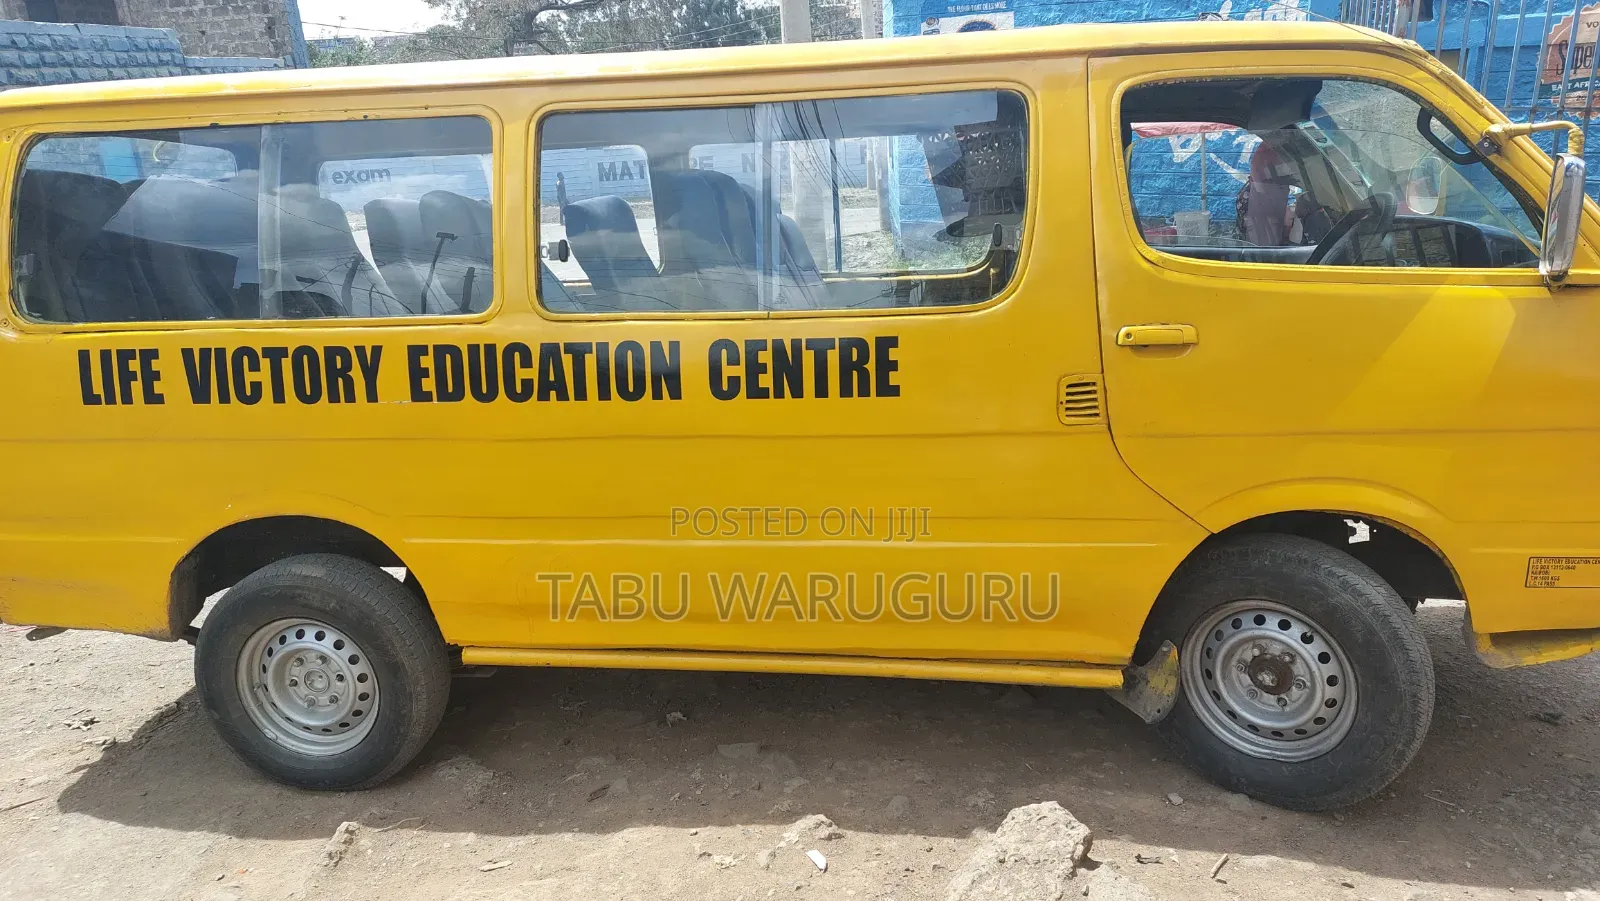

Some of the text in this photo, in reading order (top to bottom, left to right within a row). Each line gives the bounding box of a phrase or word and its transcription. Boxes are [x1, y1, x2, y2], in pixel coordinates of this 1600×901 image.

[1552, 82, 1572, 91] EAT
[332, 168, 391, 185] exam
[78, 336, 900, 405] LIFE VICTORY EDUCATION CENTRE
